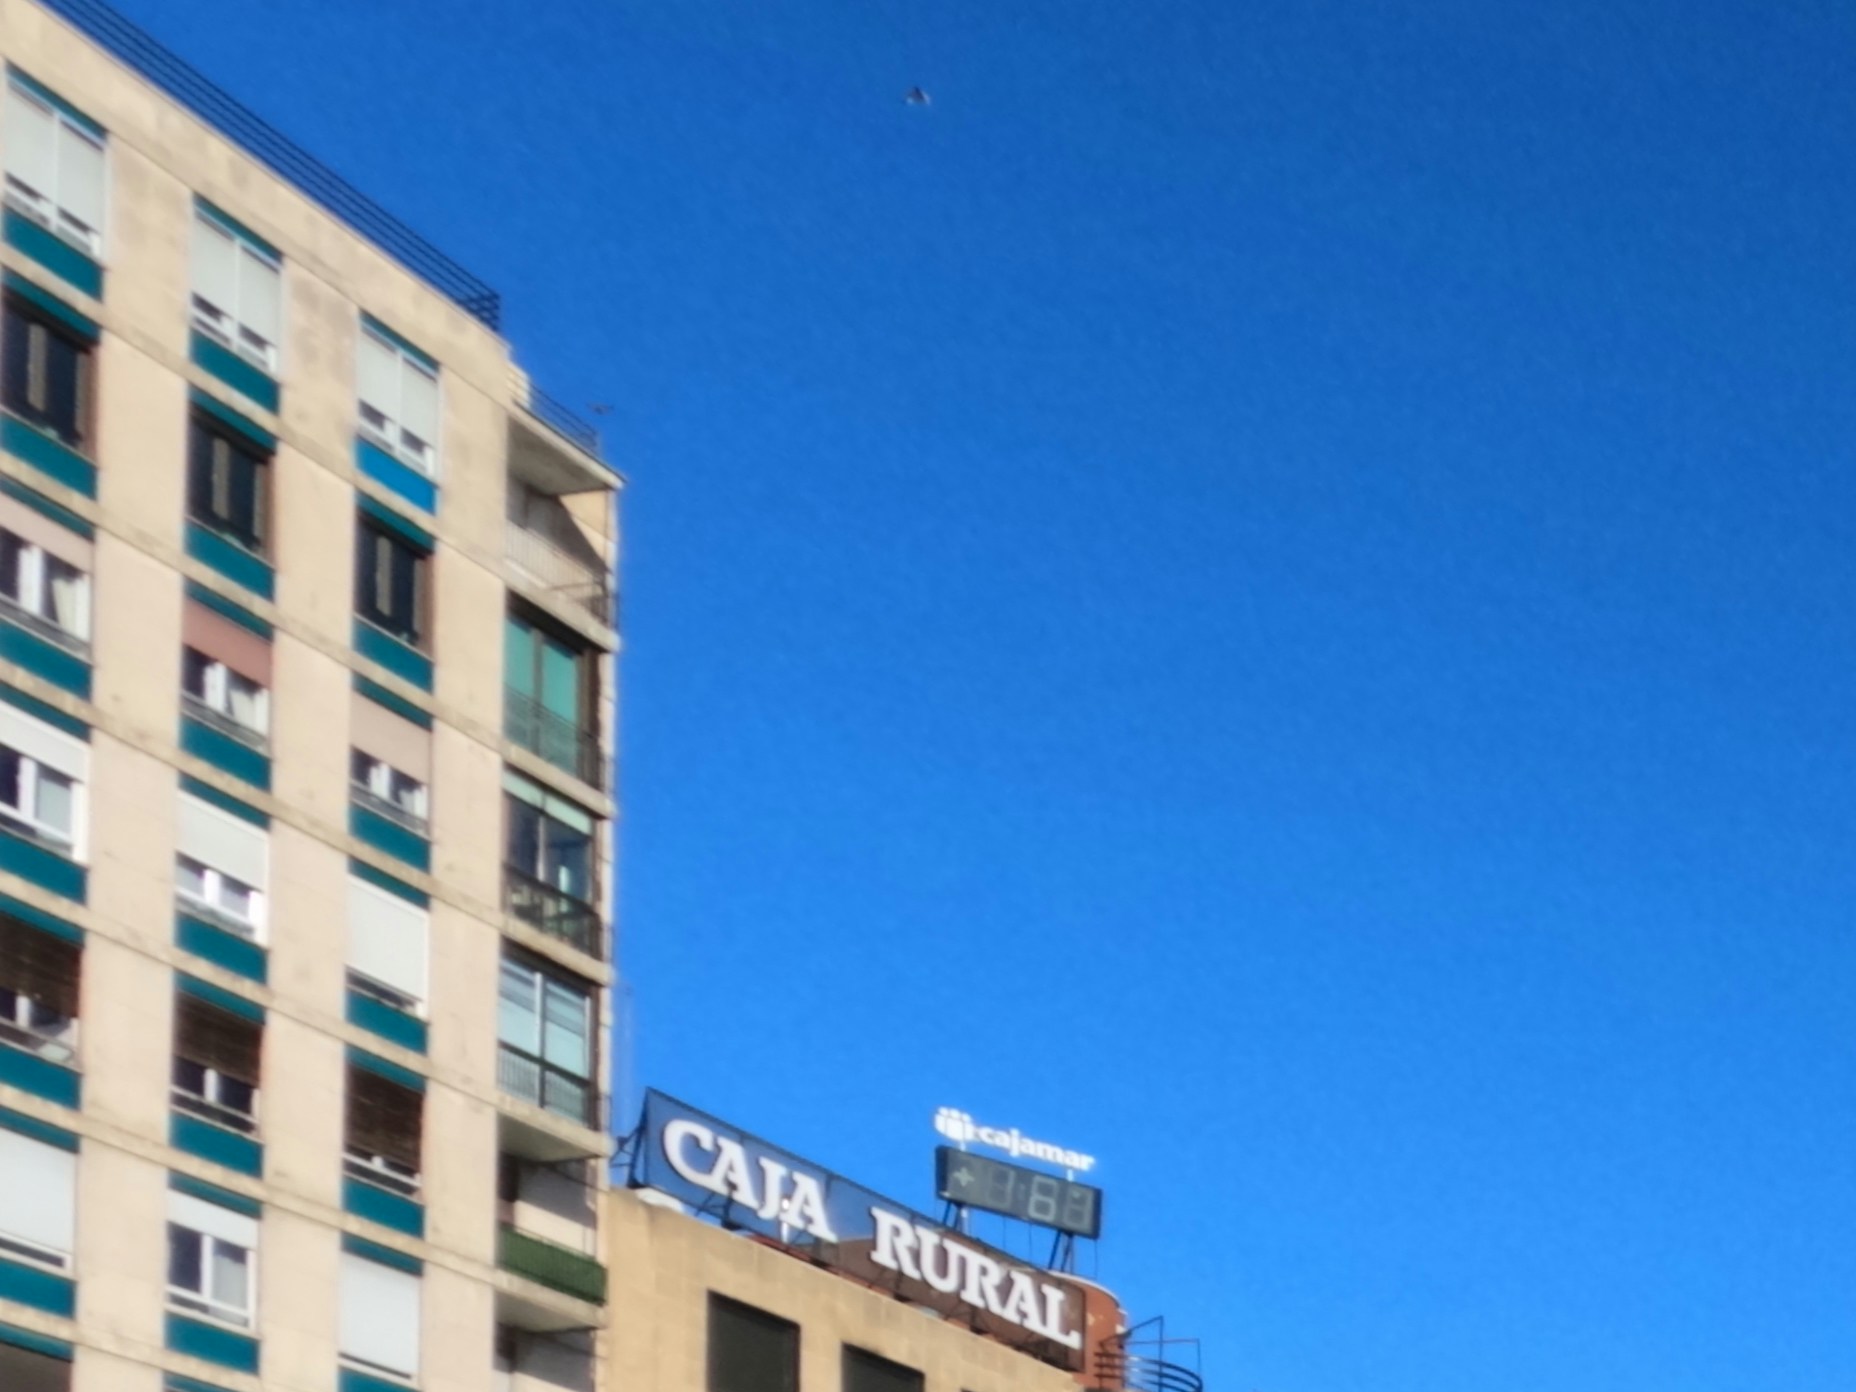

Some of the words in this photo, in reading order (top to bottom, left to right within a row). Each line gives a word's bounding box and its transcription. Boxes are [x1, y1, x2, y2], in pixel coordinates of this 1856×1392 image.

[977, 1126, 1096, 1171] cajamar
[663, 1119, 839, 1244] CAJA
[869, 1206, 1082, 1351] RURAL
